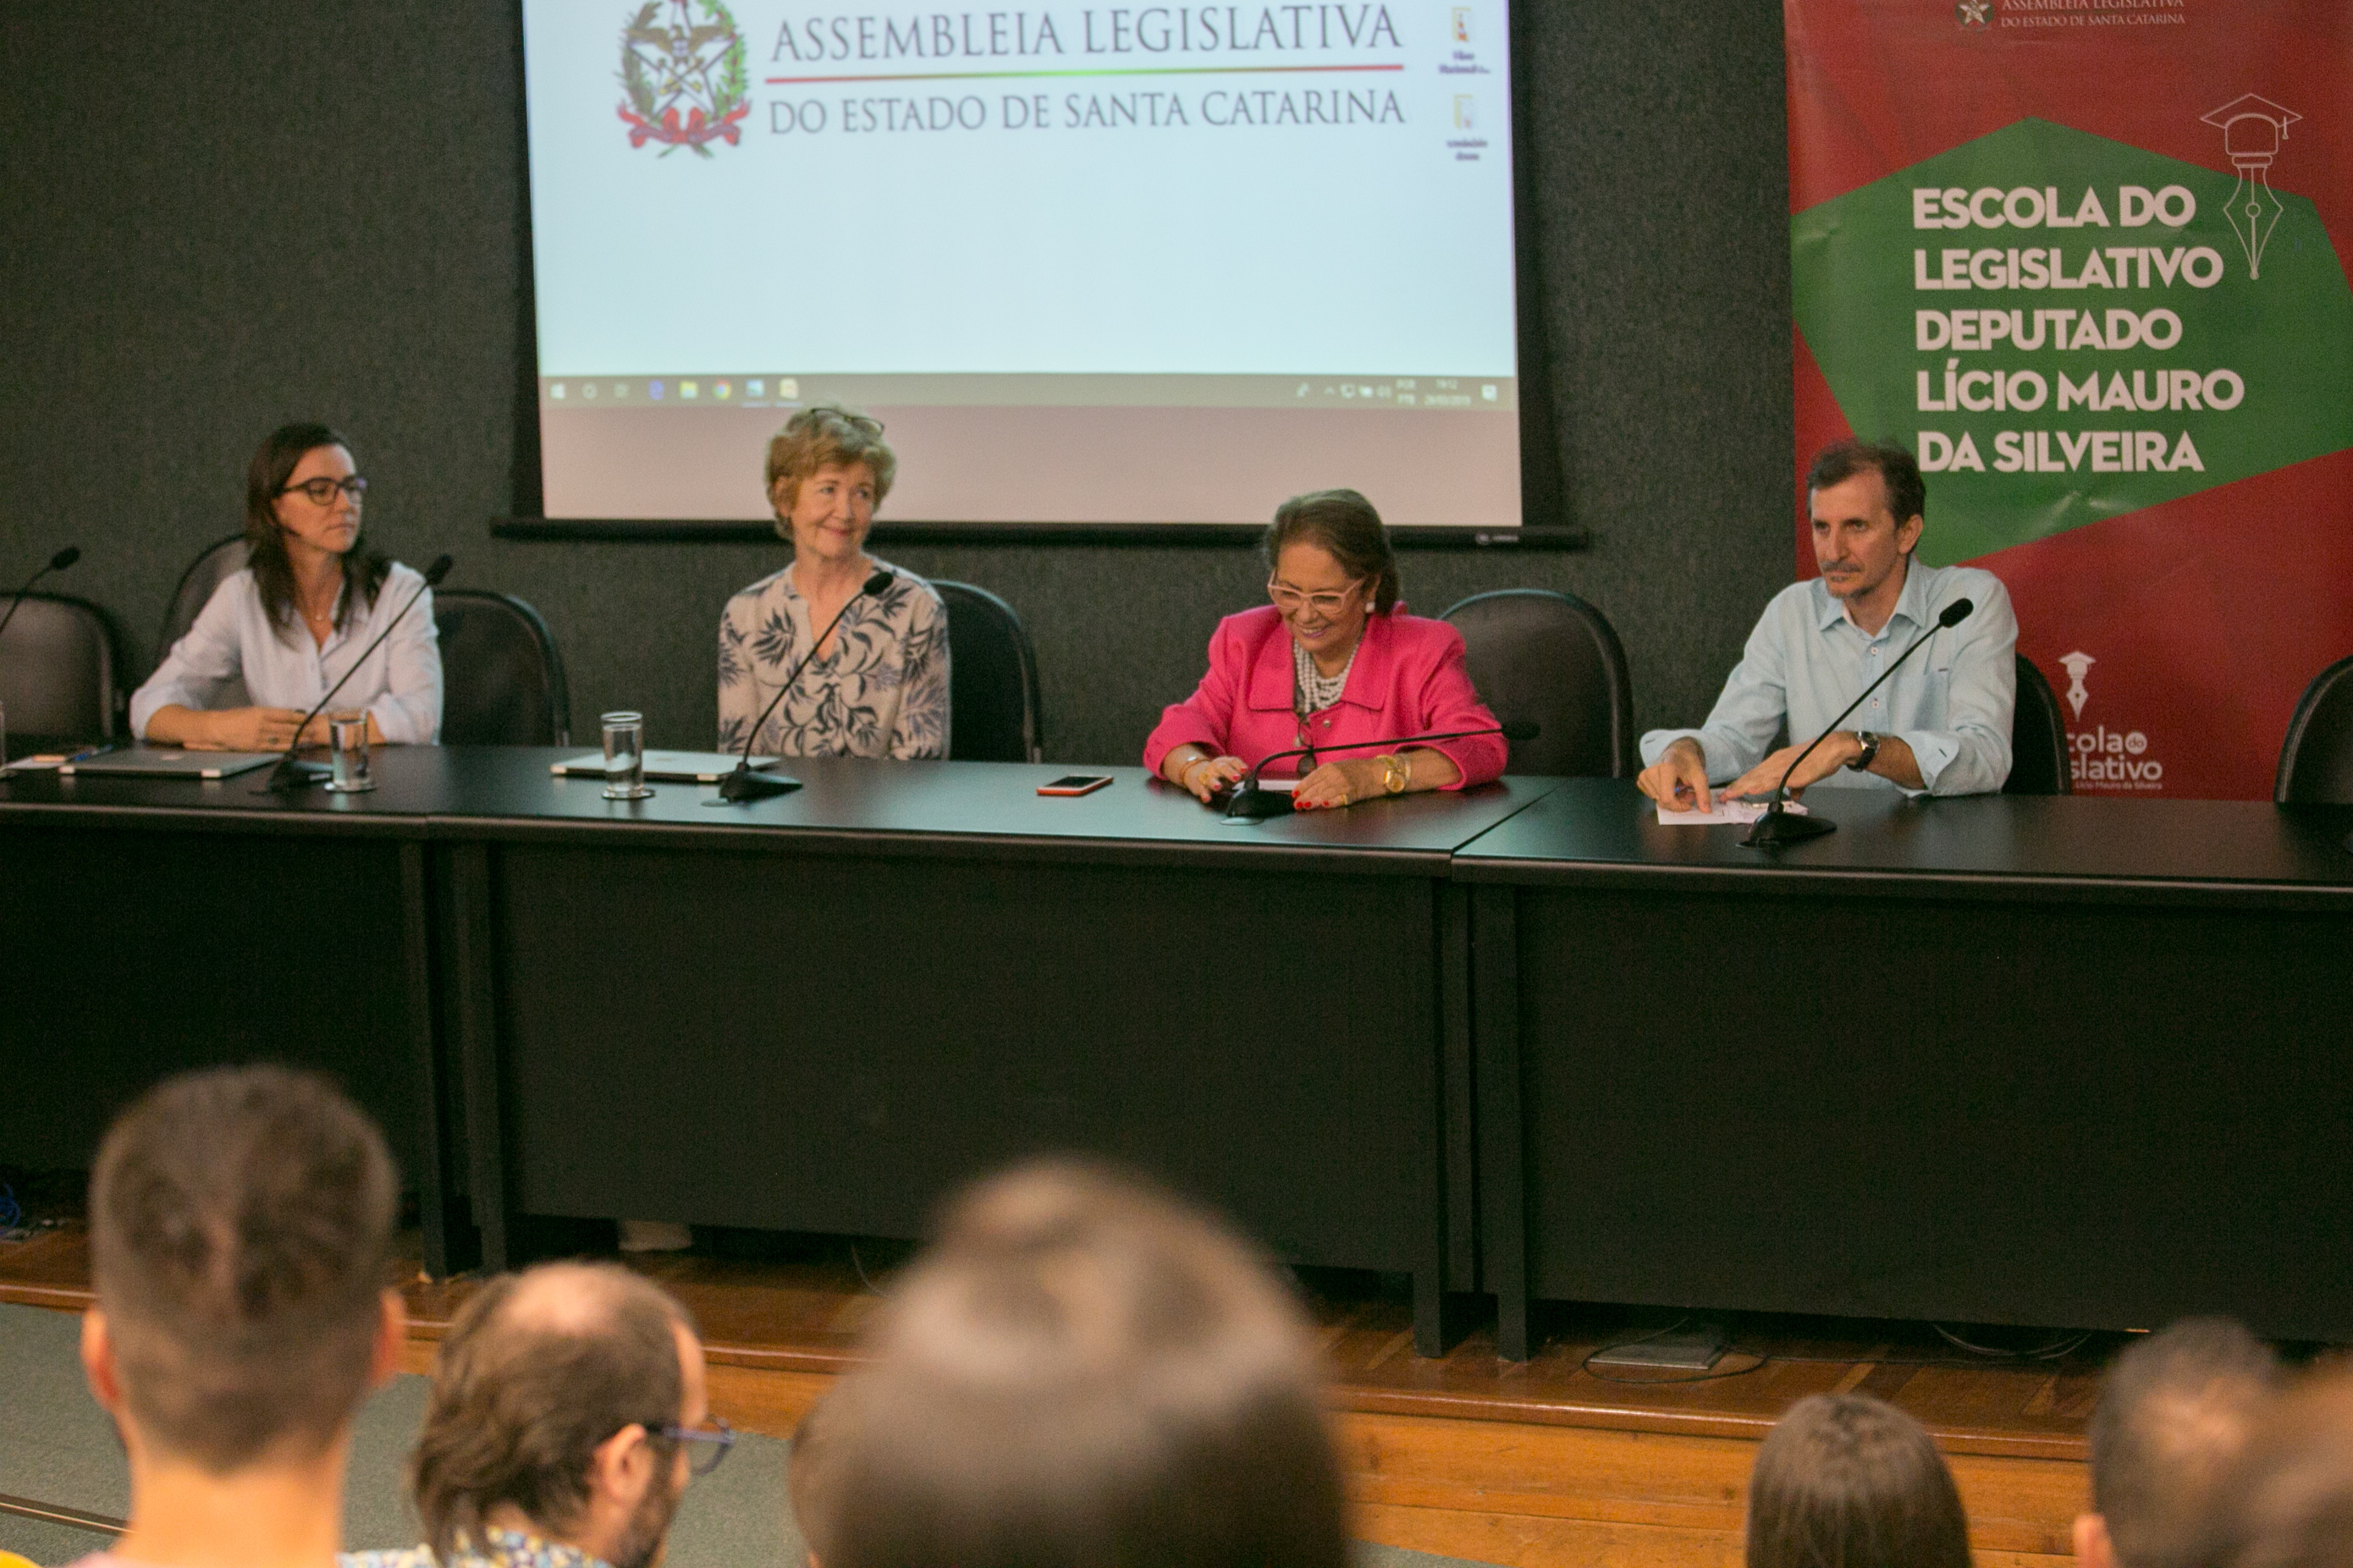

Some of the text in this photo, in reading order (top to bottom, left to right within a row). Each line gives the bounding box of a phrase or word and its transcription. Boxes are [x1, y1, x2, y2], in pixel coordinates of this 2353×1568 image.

[2001, 0, 2185, 10] ASSEMBLEIA LEGISLATIVA
[2001, 13, 2185, 27] DO ESTADO DE SANTA CATARINA
[771, 3, 1402, 63] ASSEMBLEIA LEGISLATIVA
[769, 89, 1406, 135] DO ESTADO DE SANTA CATARINA
[1913, 184, 2196, 229] ESCOLA DO
[1914, 246, 2224, 290] LEGISLATIVO
[1915, 308, 2182, 351] DEPUTADO
[1916, 358, 2245, 412] LÍCIO MAURO
[1918, 431, 2205, 472] DA SILVEIRA
